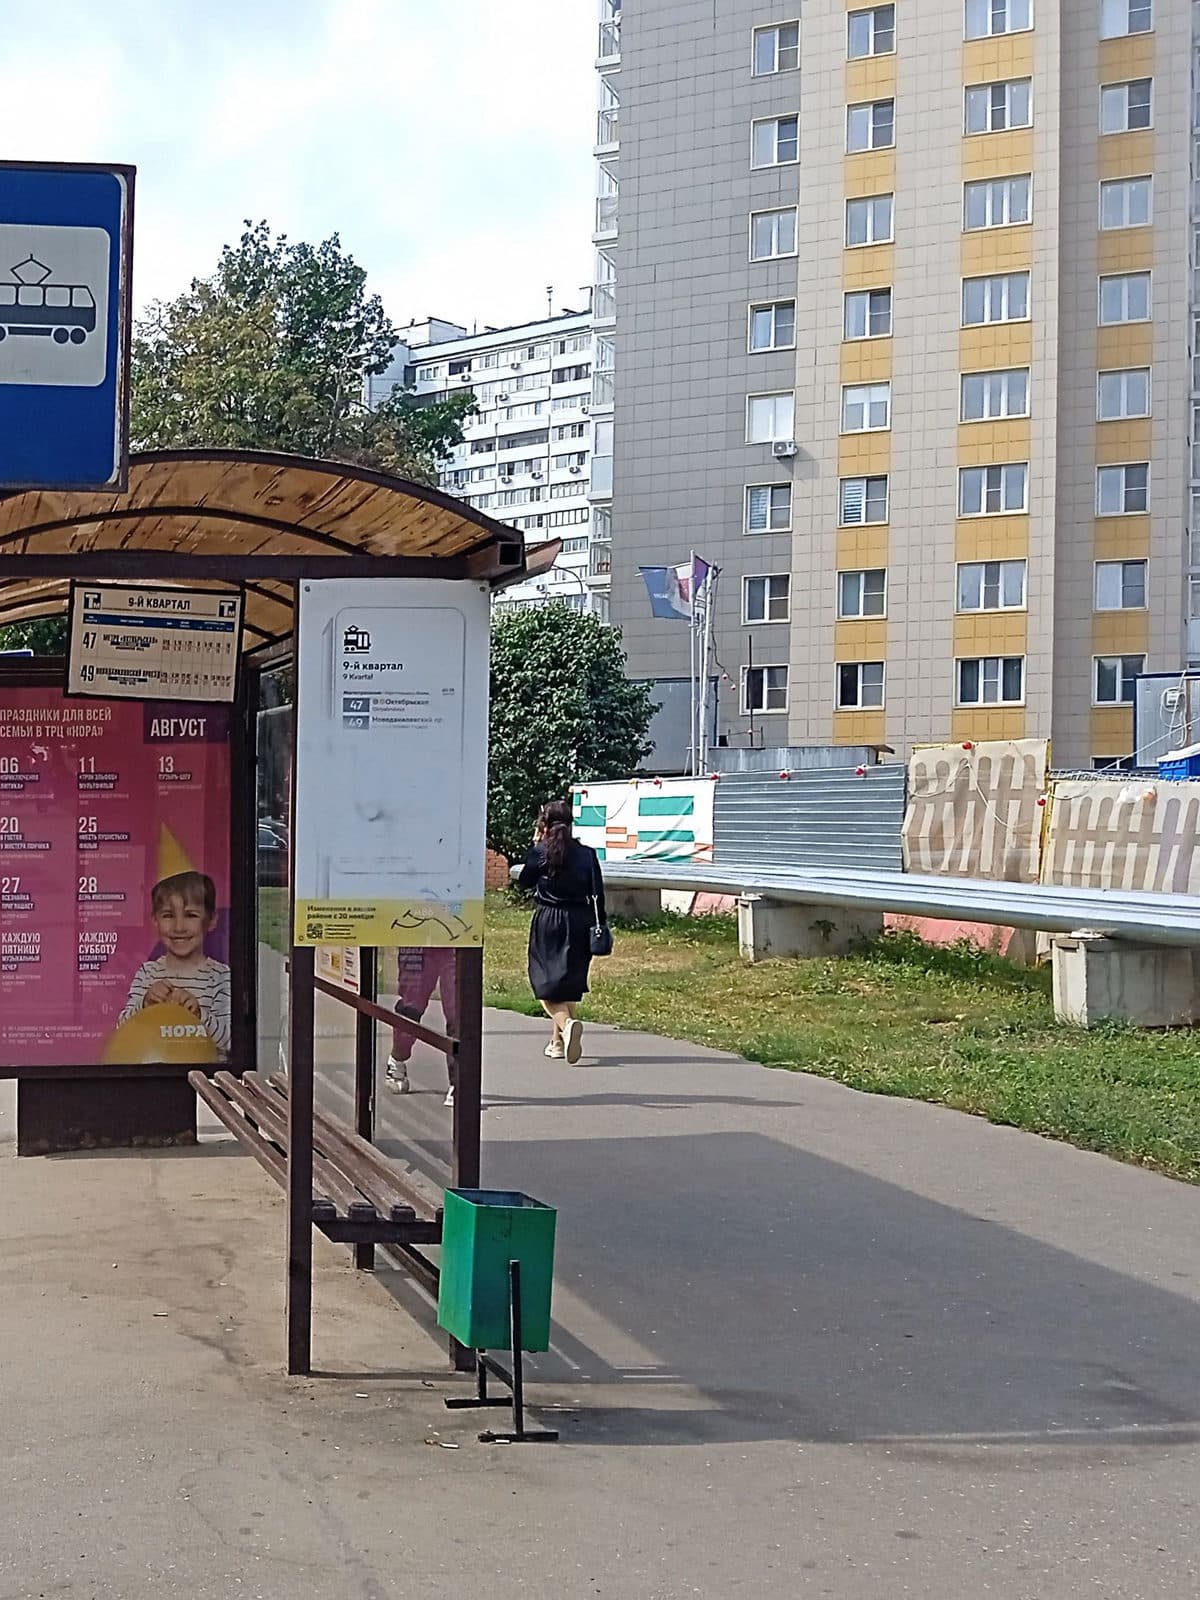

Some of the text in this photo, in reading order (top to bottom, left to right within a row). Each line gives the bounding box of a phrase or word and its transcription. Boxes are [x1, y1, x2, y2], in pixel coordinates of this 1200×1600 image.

[128, 596, 191, 610] 9-Й КВАРТАЛ
[83, 632, 97, 649] 47
[81, 665, 95, 682] 49
[343, 661, 403, 672] 9-й квартал
[349, 700, 363, 710] 47
[0, 707, 112, 723] ПРАЗДНИКИ ДЛЯ ВСЕЙ
[0, 725, 103, 739] СЕМЬИ В ТРЦ «НОРА»
[151, 718, 207, 737] АВГУСТ
[0, 757, 19, 774] 06
[79, 756, 95, 773] 11
[158, 756, 174, 773] 13
[0, 816, 19, 833] 20
[79, 816, 97, 833] 25
[2, 877, 20, 893] 27
[79, 877, 97, 893] 28
[2, 932, 40, 943] КАЖДУЮ
[79, 932, 118, 943] КАЖДУЮ
[2, 944, 40, 955] ПЯТНИЦУ
[79, 944, 116, 955] СУББОТУ
[160, 1025, 207, 1037] НОРА
